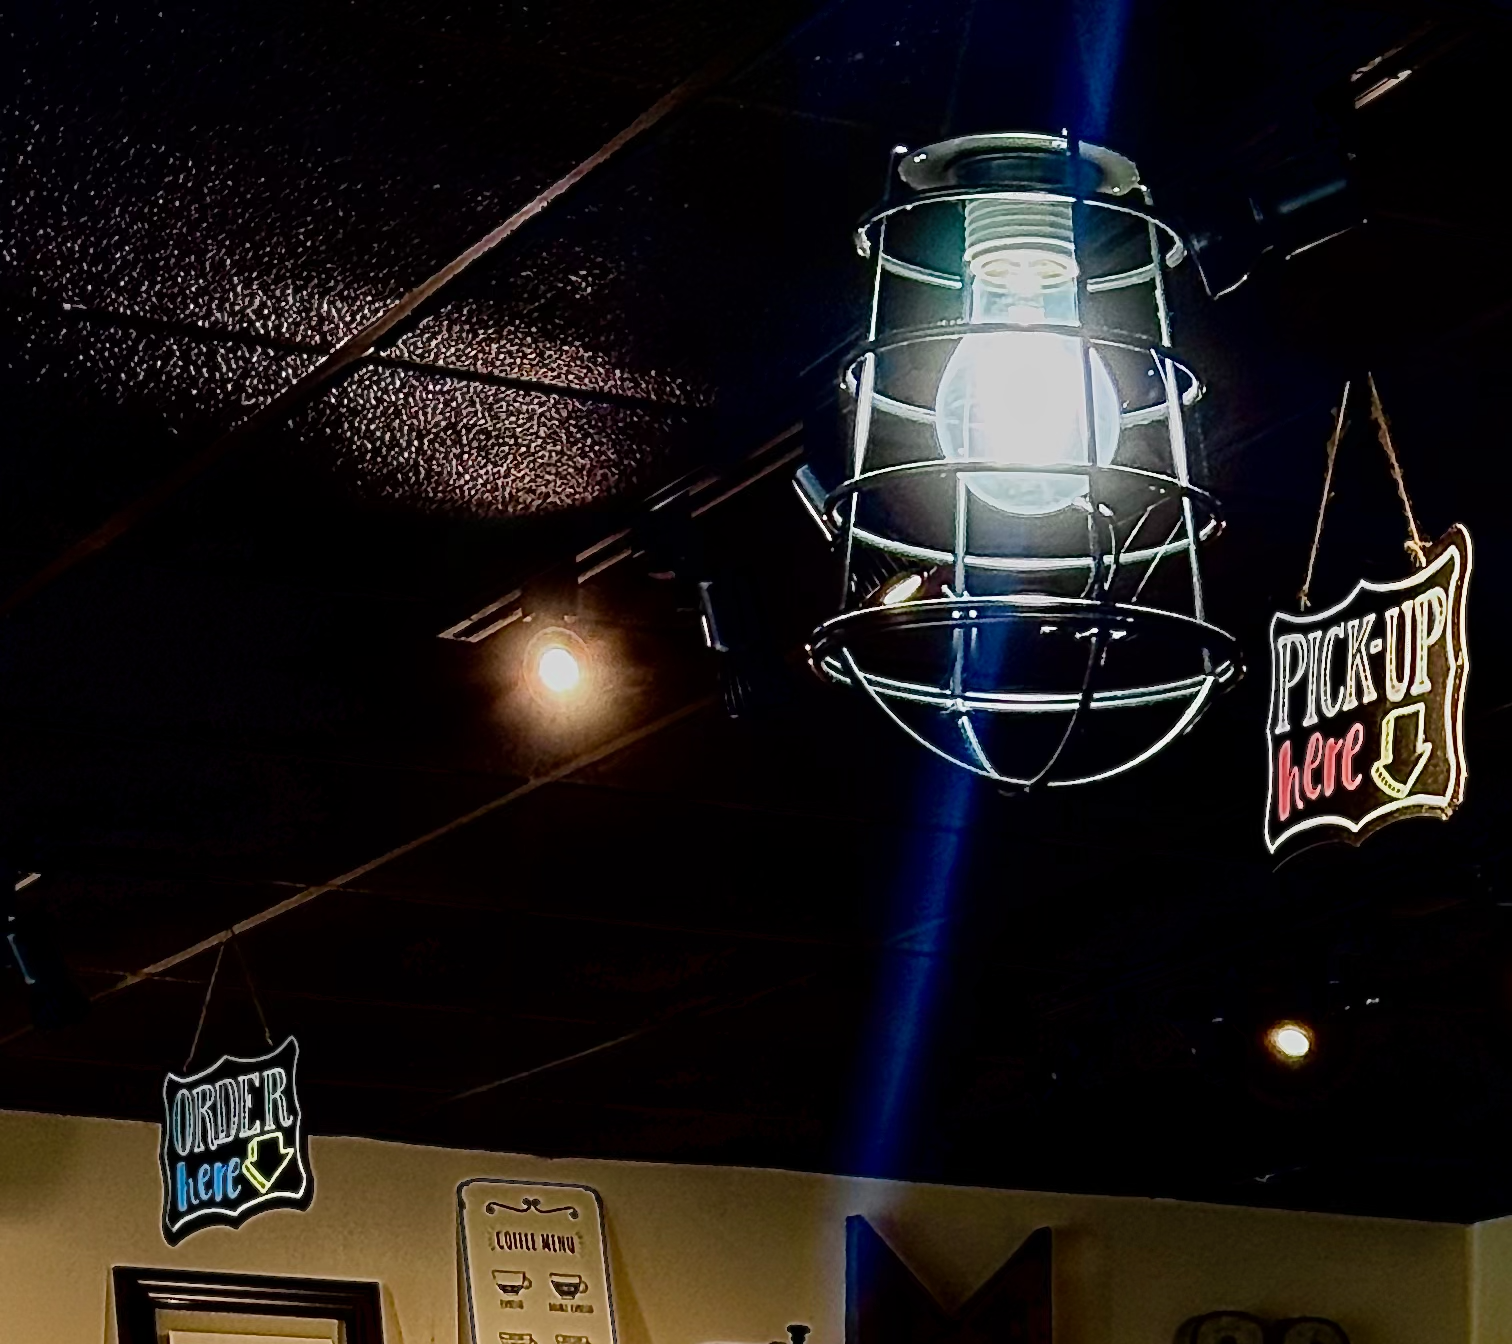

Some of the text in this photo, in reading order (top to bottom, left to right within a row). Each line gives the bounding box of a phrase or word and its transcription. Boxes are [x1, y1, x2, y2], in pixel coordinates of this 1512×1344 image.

[1275, 587, 1447, 734] PICK-UP
[1278, 723, 1364, 821] here
[173, 1067, 293, 1156] ORDER
[177, 1158, 241, 1211] here
[541, 1234, 575, 1254] MENU
